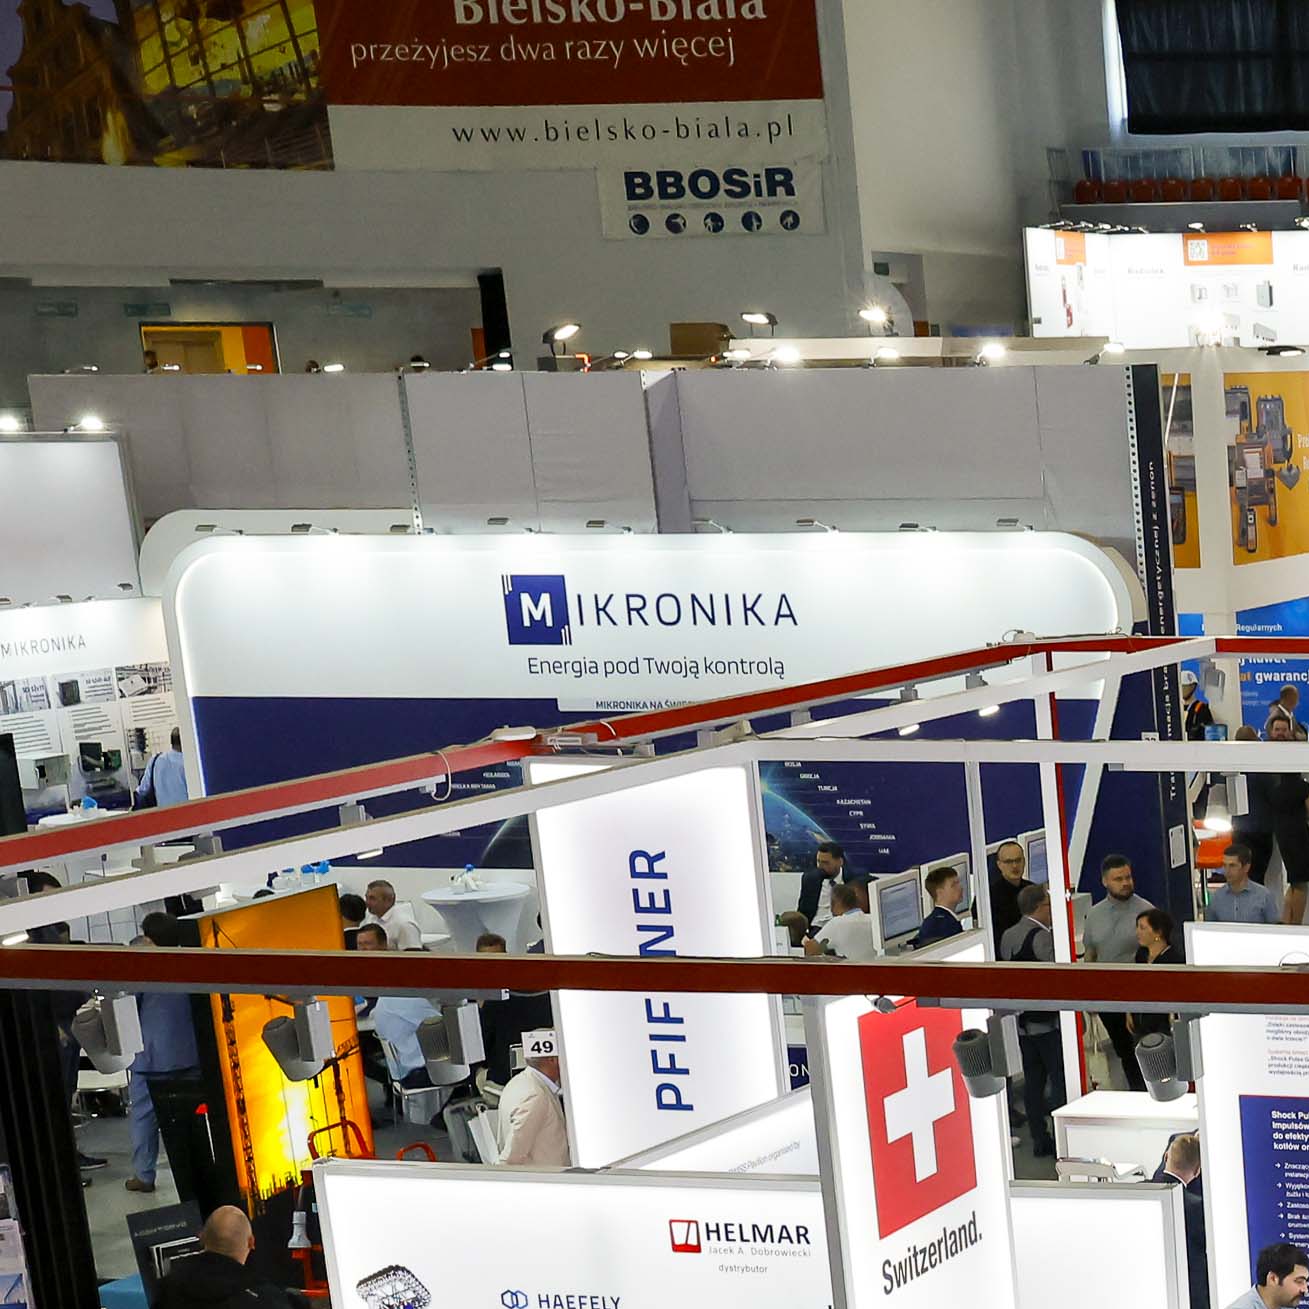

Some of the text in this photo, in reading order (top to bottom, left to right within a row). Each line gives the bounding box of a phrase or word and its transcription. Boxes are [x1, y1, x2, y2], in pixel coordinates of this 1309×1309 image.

[351, 30, 735, 69] przeżyjesz dwa razy więcej
[452, 114, 795, 144] www.bielsko-biala.pl
[624, 168, 796, 200] BBOSiR
[528, 656, 785, 680] Energia pod Twoją kontrolą
[596, 700, 649, 710] MIKRONIKA
[629, 850, 694, 1111] PFIFNER
[530, 1040, 553, 1054] 49
[1271, 1111, 1296, 1119] Shock
[1273, 1142, 1300, 1151] kotłów
[704, 1222, 811, 1245] HELMAR
[709, 1246, 734, 1256] Jacek
[751, 1247, 811, 1258] Dobrowiecki
[882, 1211, 982, 1295] Switzerland.
[718, 1263, 768, 1274] dystrybutor
